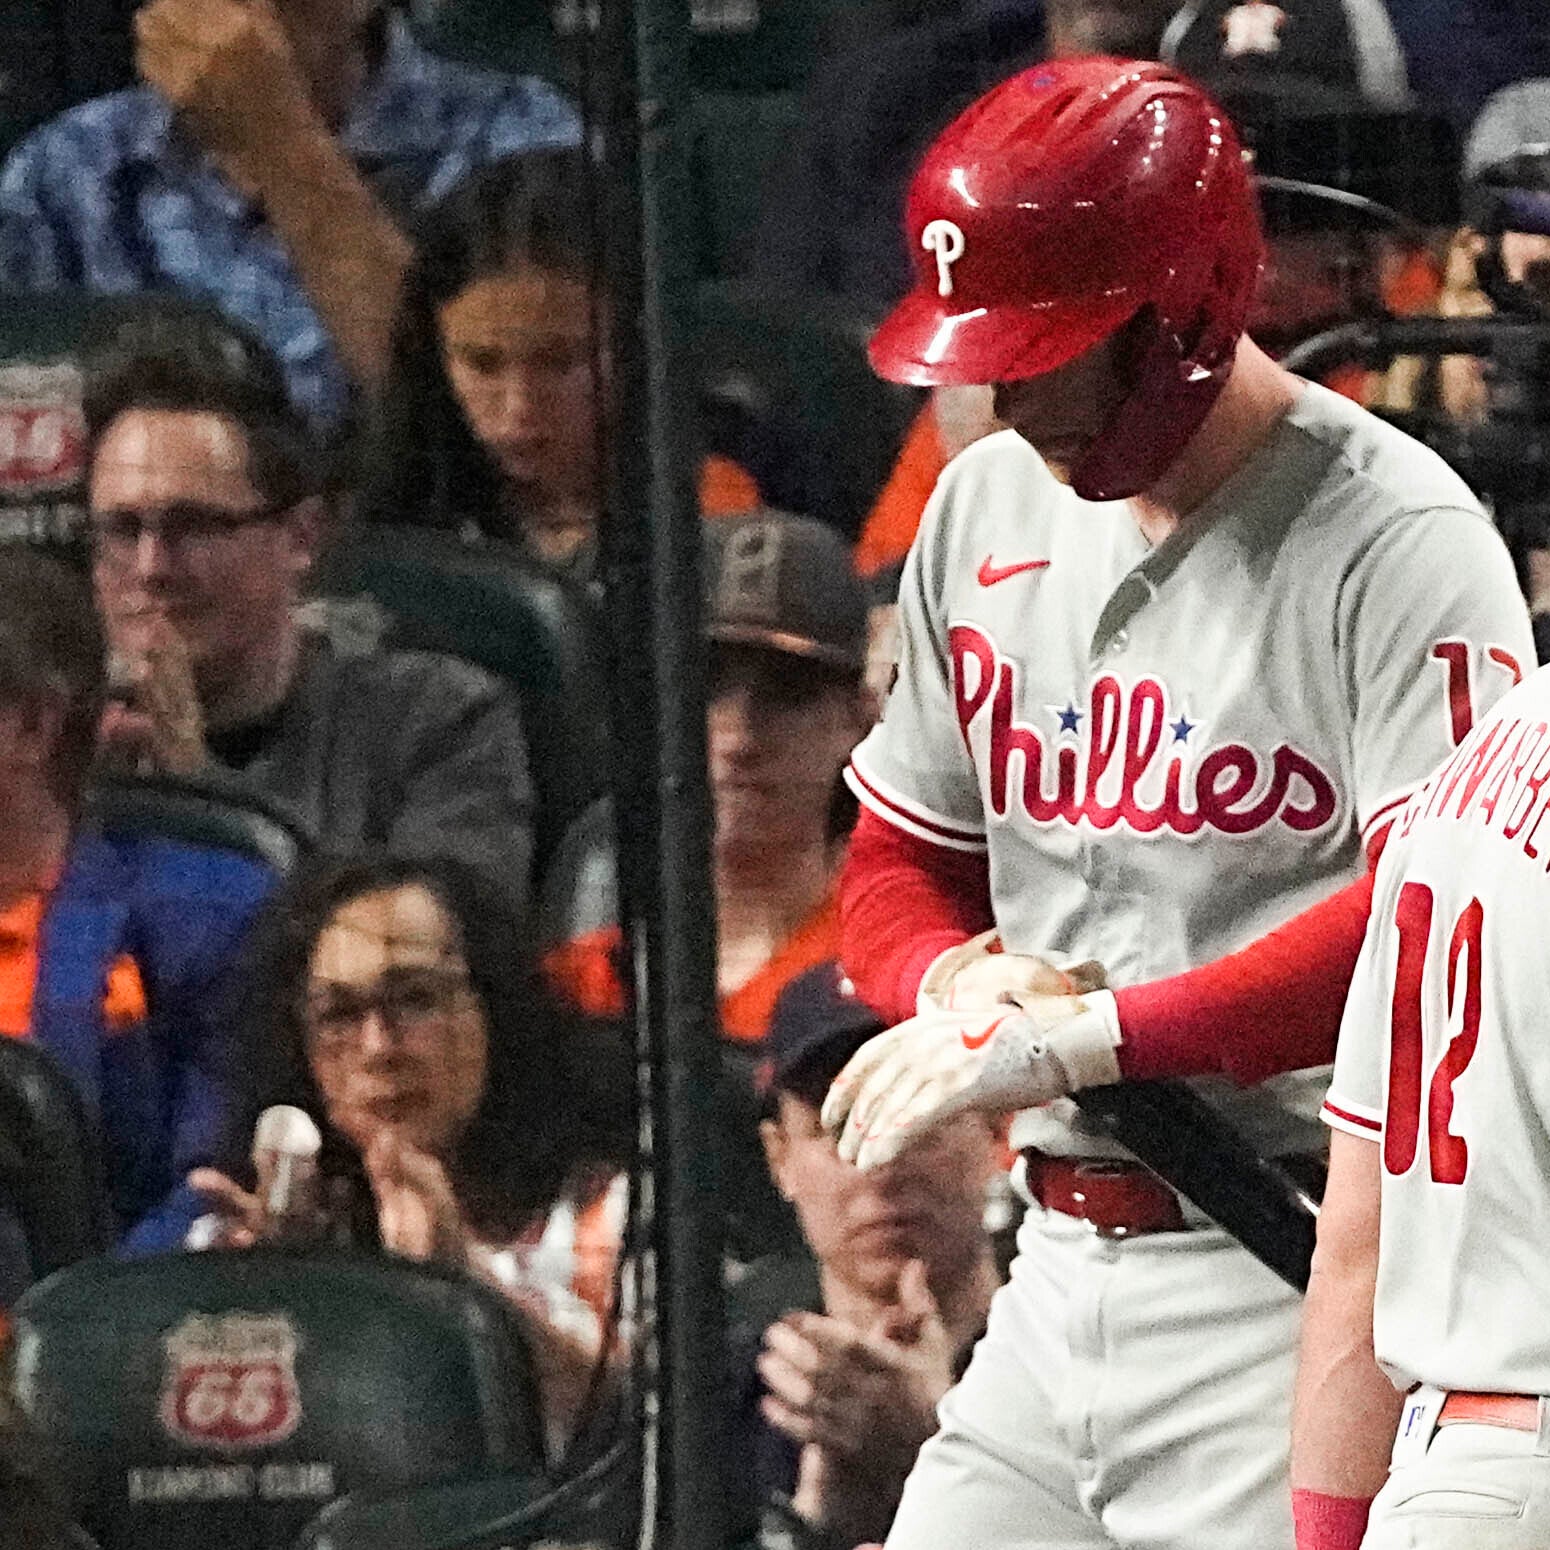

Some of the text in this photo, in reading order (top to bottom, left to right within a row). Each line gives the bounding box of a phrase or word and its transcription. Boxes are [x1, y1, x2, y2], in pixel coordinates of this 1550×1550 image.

[921, 219, 966, 297] P
[948, 624, 1338, 836] Phillies
[1384, 881, 1483, 1185] 12
[185, 1370, 276, 1426] 66
